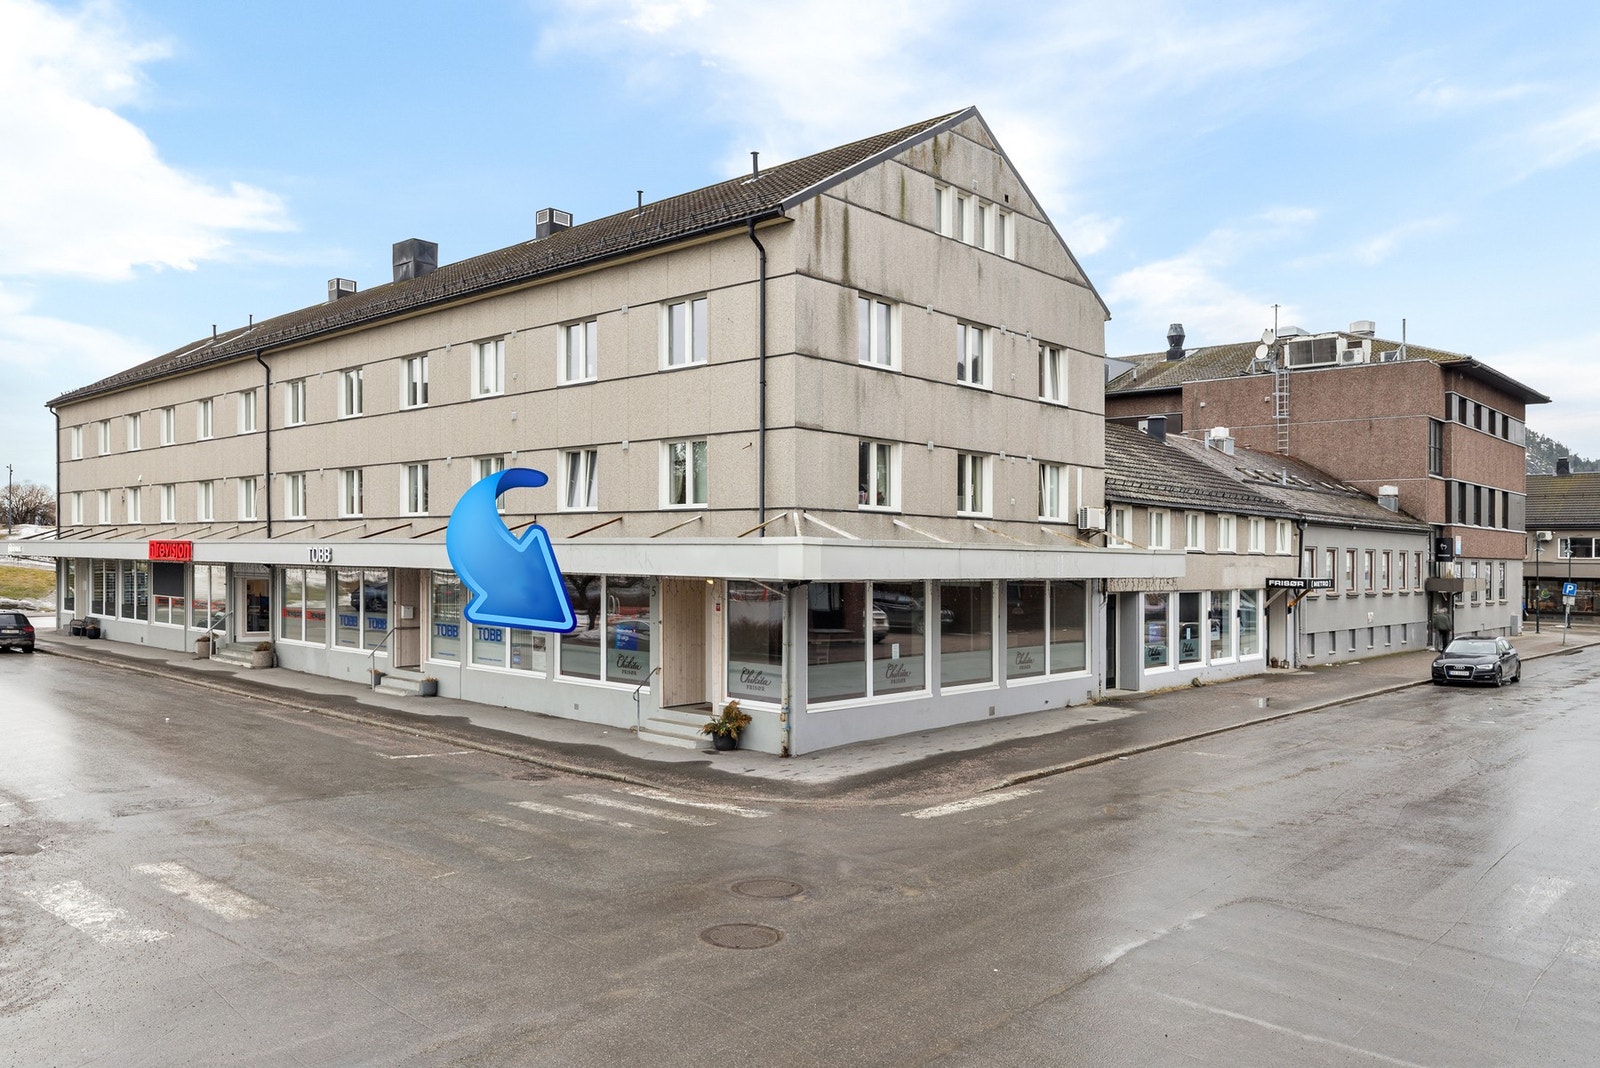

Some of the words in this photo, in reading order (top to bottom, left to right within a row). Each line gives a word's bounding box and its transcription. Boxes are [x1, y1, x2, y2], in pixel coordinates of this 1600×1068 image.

[306, 547, 332, 562] TOBB
[1268, 579, 1304, 587] FRISØR
[1566, 584, 1574, 593] P
[651, 586, 657, 597] 5
[339, 614, 358, 627] TOBB
[367, 617, 387, 630] TOBB
[435, 624, 459, 637] TOBB
[477, 627, 502, 641] TOBB
